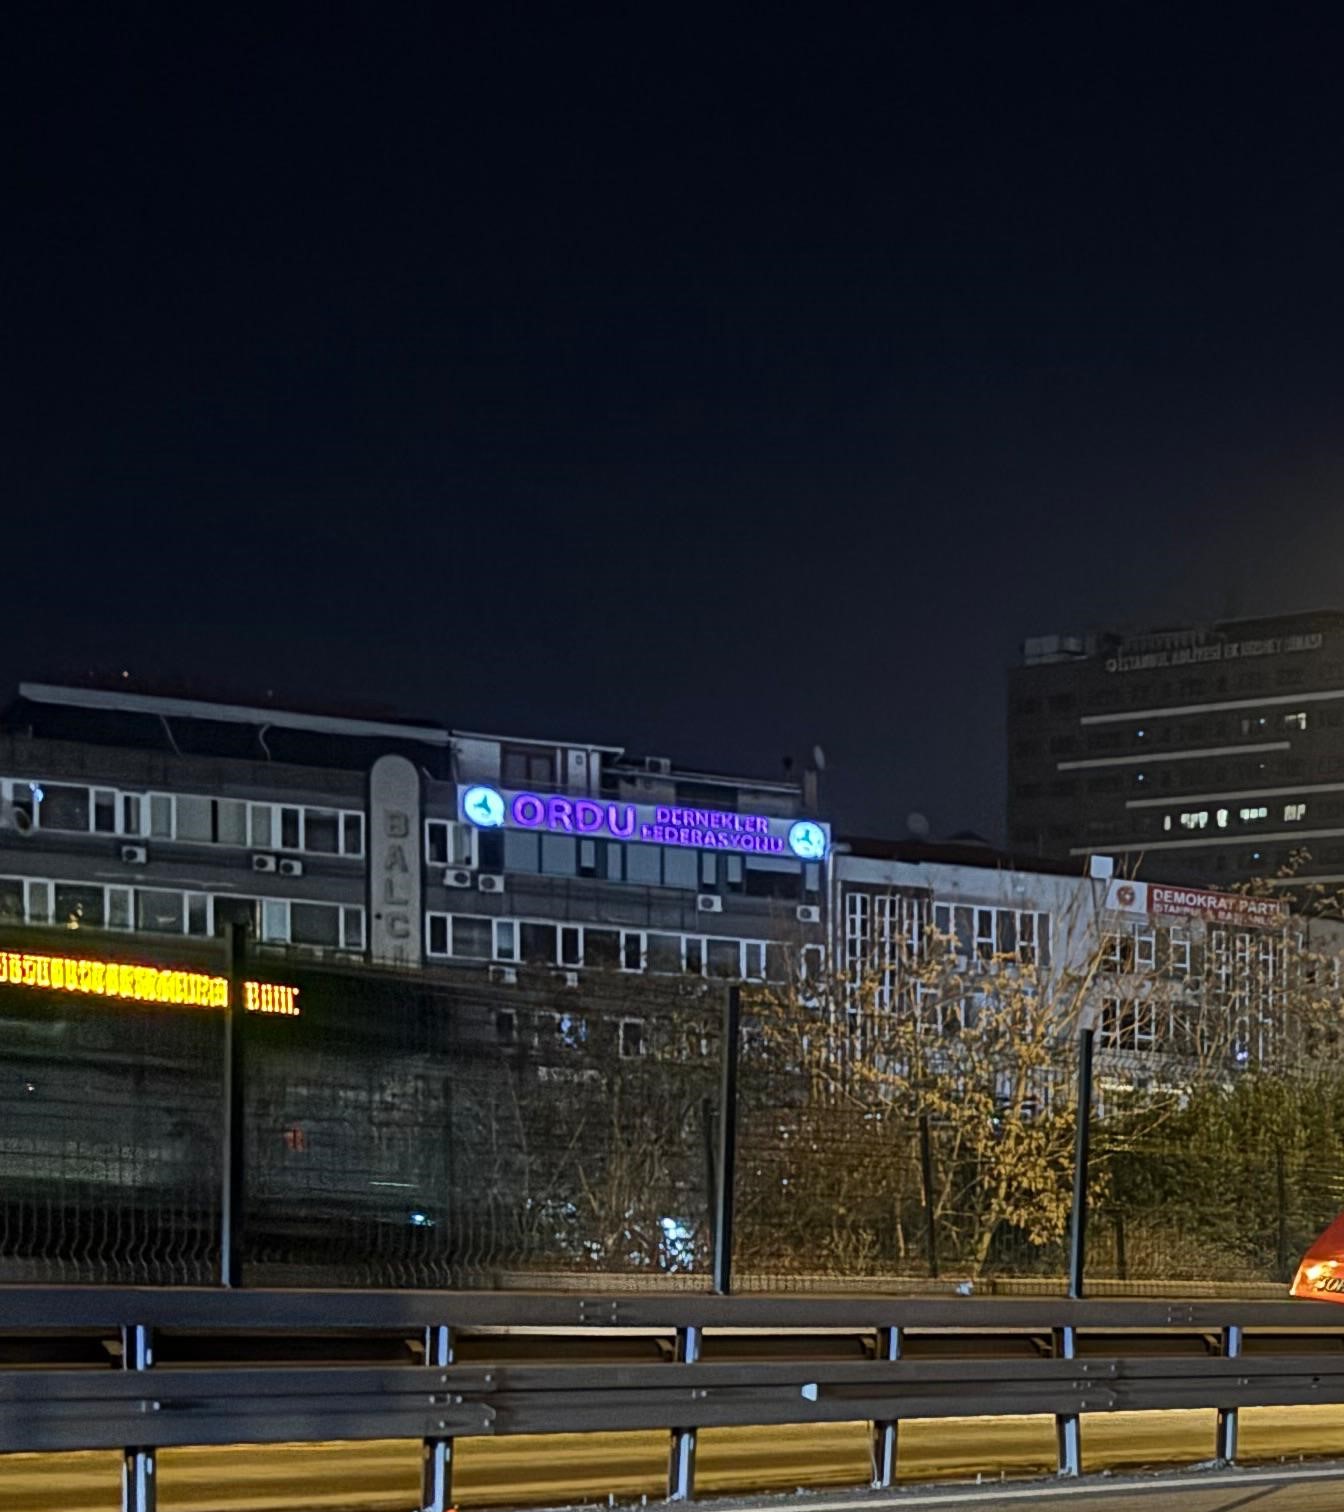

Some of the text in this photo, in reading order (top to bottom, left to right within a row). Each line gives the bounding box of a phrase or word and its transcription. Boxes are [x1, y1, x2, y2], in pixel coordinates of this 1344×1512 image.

[512, 793, 768, 838] ORDU DERNEKLER
[641, 824, 785, 852] FEDERASYONU
[1153, 888, 1235, 912] DEMOKRAT
